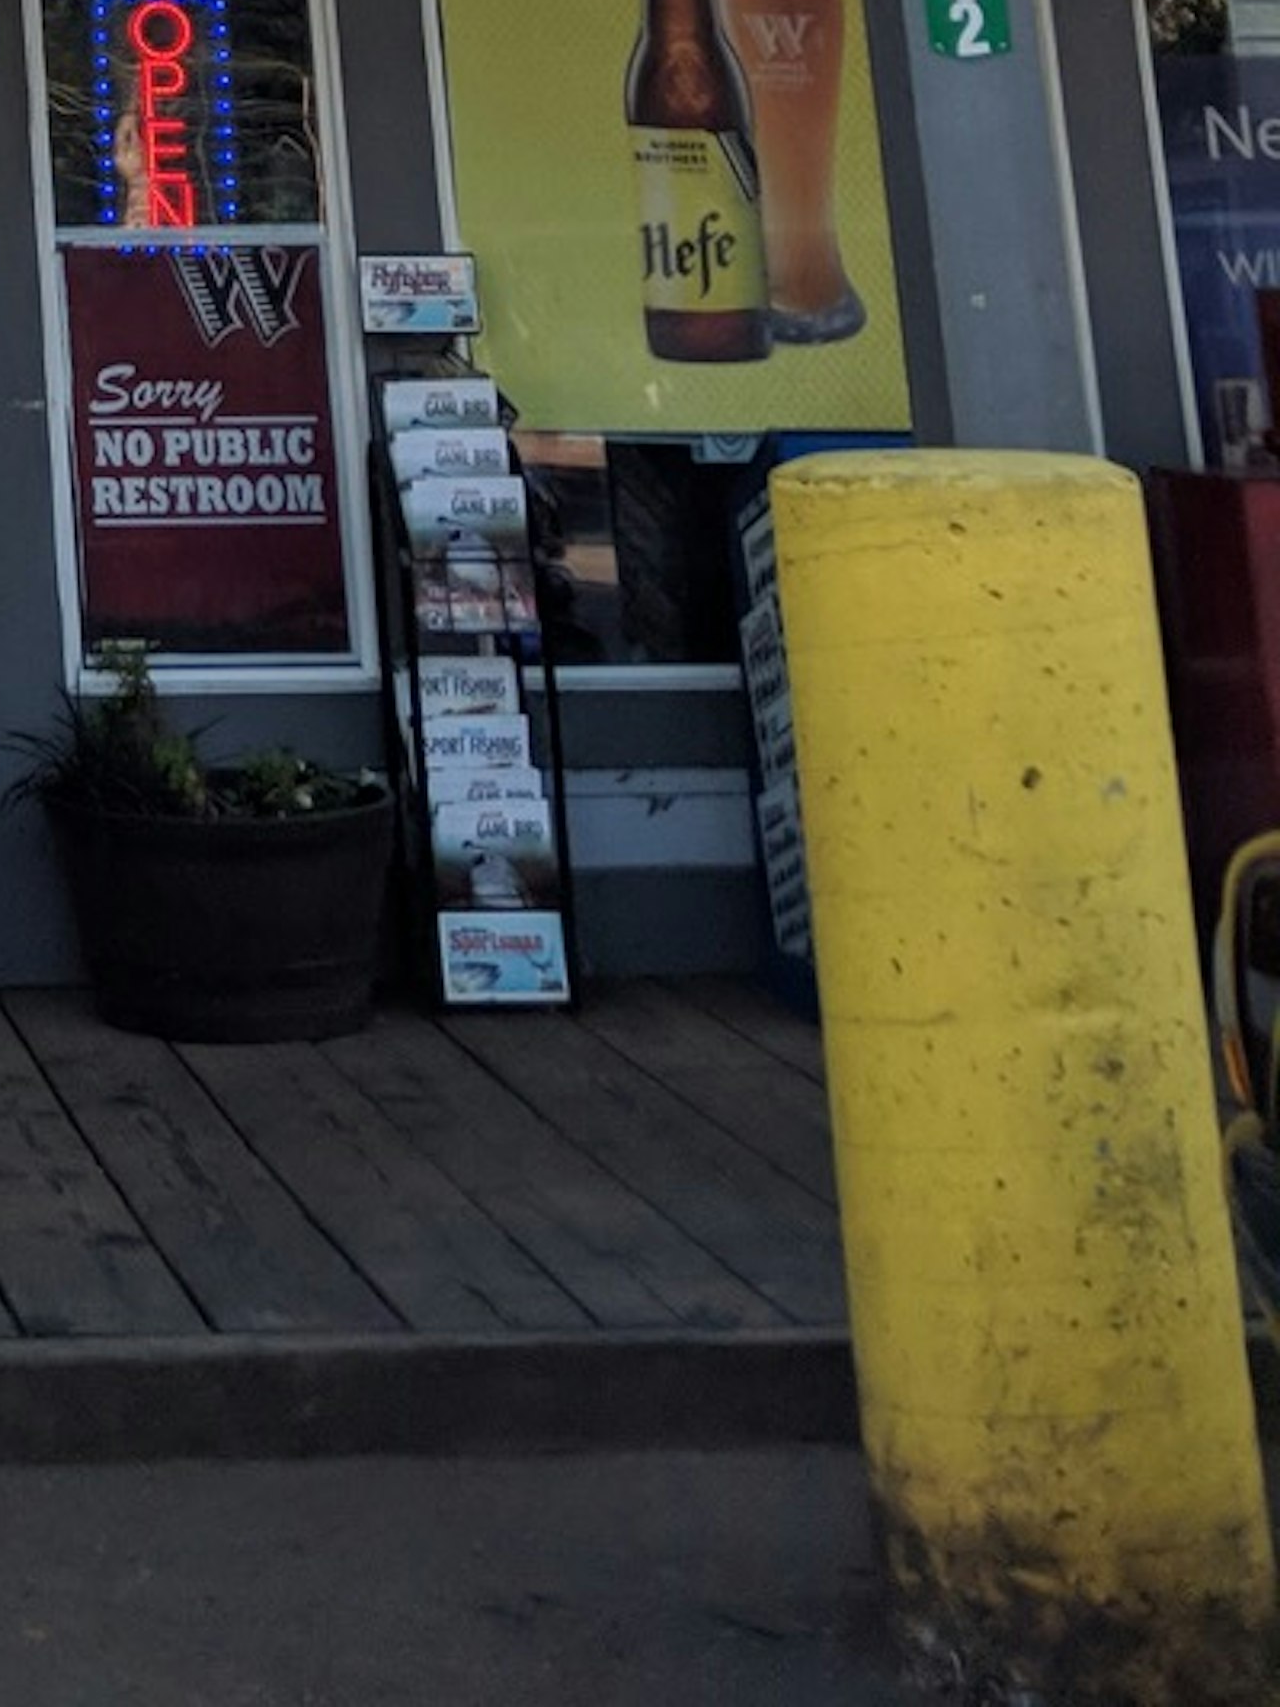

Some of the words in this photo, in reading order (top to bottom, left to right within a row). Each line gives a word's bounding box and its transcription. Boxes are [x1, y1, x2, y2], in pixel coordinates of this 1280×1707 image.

[640, 211, 737, 295] Hefe
[88, 363, 225, 420] Sorry
[94, 429, 154, 469] NO
[163, 426, 315, 467] PUBLIC
[92, 474, 325, 515] RESTROOM
